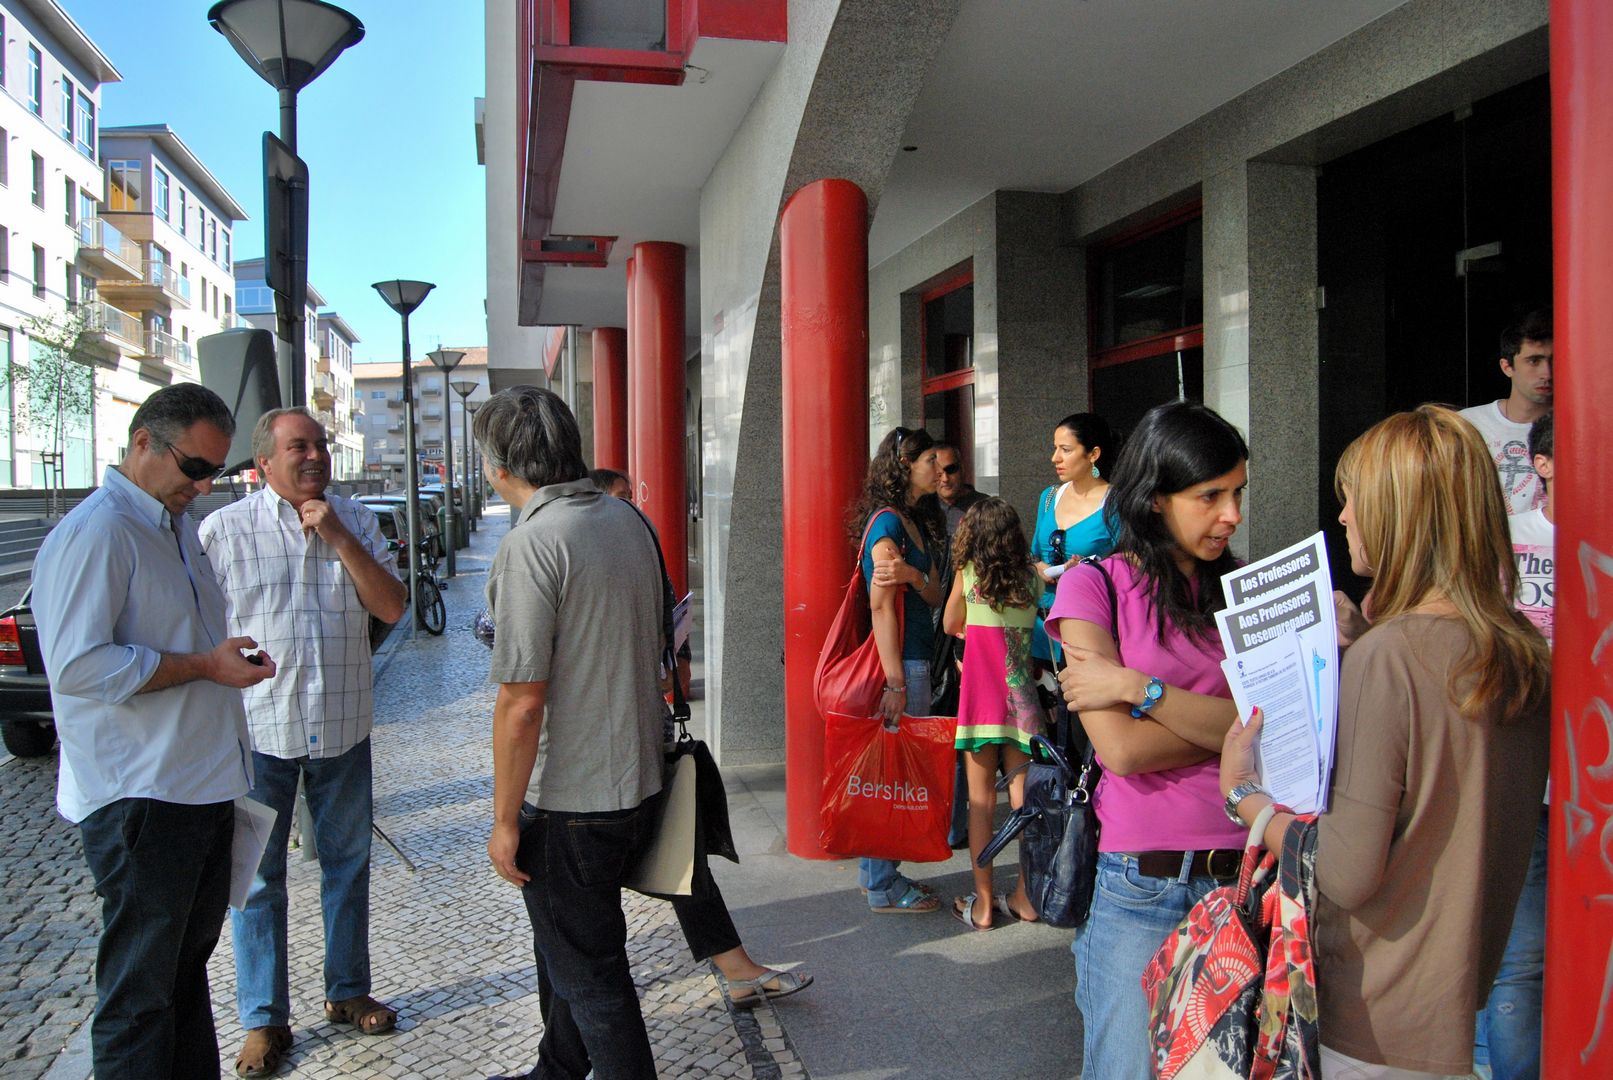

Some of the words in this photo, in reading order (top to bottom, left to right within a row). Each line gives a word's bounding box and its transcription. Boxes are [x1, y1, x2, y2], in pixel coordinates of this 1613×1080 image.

[1240, 576, 1259, 593] Aos
[1257, 553, 1311, 586] Professores
[1238, 612, 1260, 630] Aos
[1258, 590, 1311, 622] Professores
[1242, 609, 1315, 648] Desempregados
[847, 775, 929, 803] Bershka
